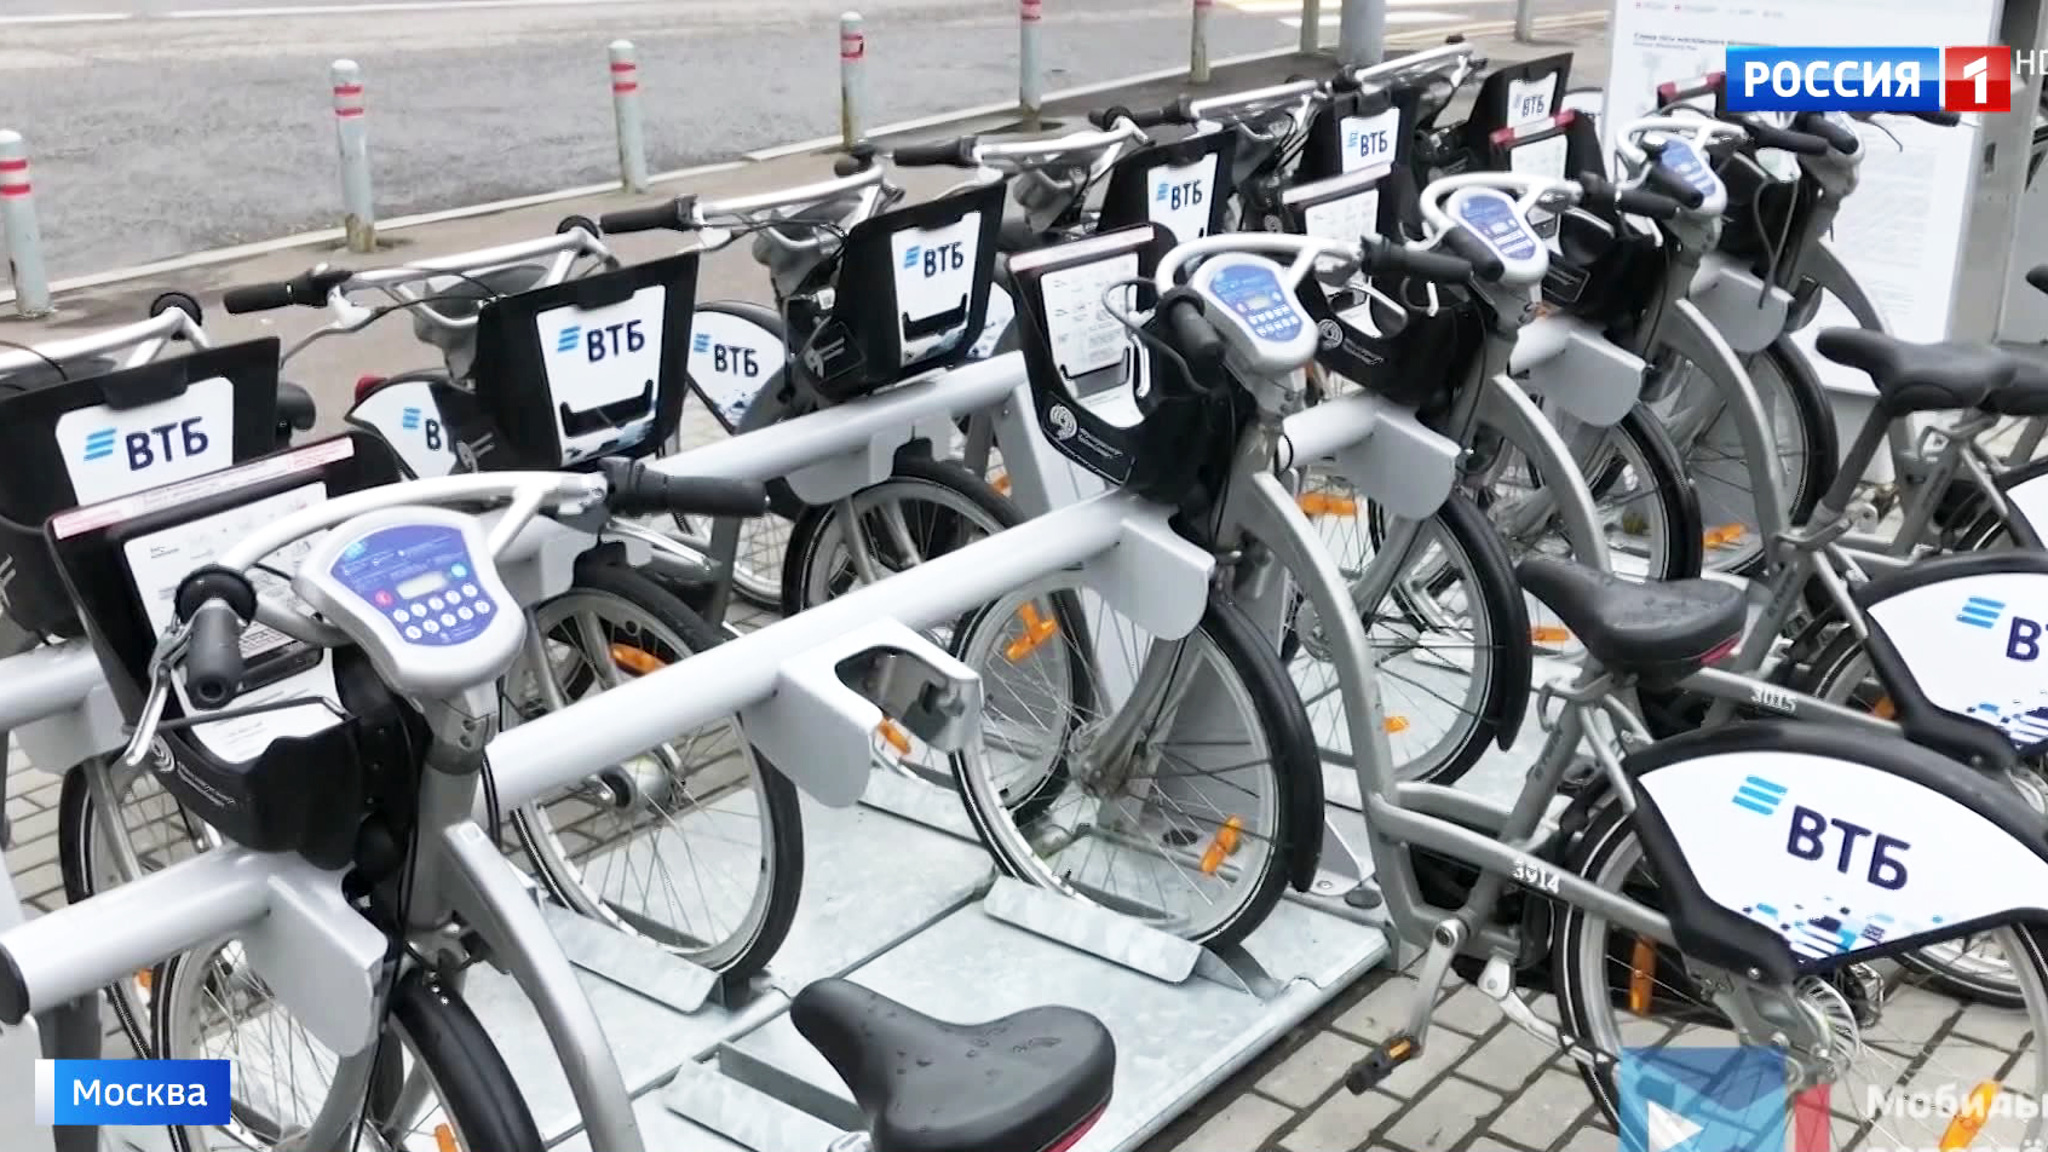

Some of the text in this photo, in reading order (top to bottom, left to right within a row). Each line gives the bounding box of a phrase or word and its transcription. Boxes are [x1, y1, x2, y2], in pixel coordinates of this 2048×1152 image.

[1360, 130, 1388, 158] ВТБ
[1170, 179, 1203, 211] ВТБ
[923, 241, 964, 278] ВТБ
[586, 318, 646, 363] ВТБ
[714, 343, 759, 378] ВТБ
[125, 415, 210, 472] ВТБ
[2006, 616, 2048, 662] В
[1786, 804, 1912, 892] ВТБ
